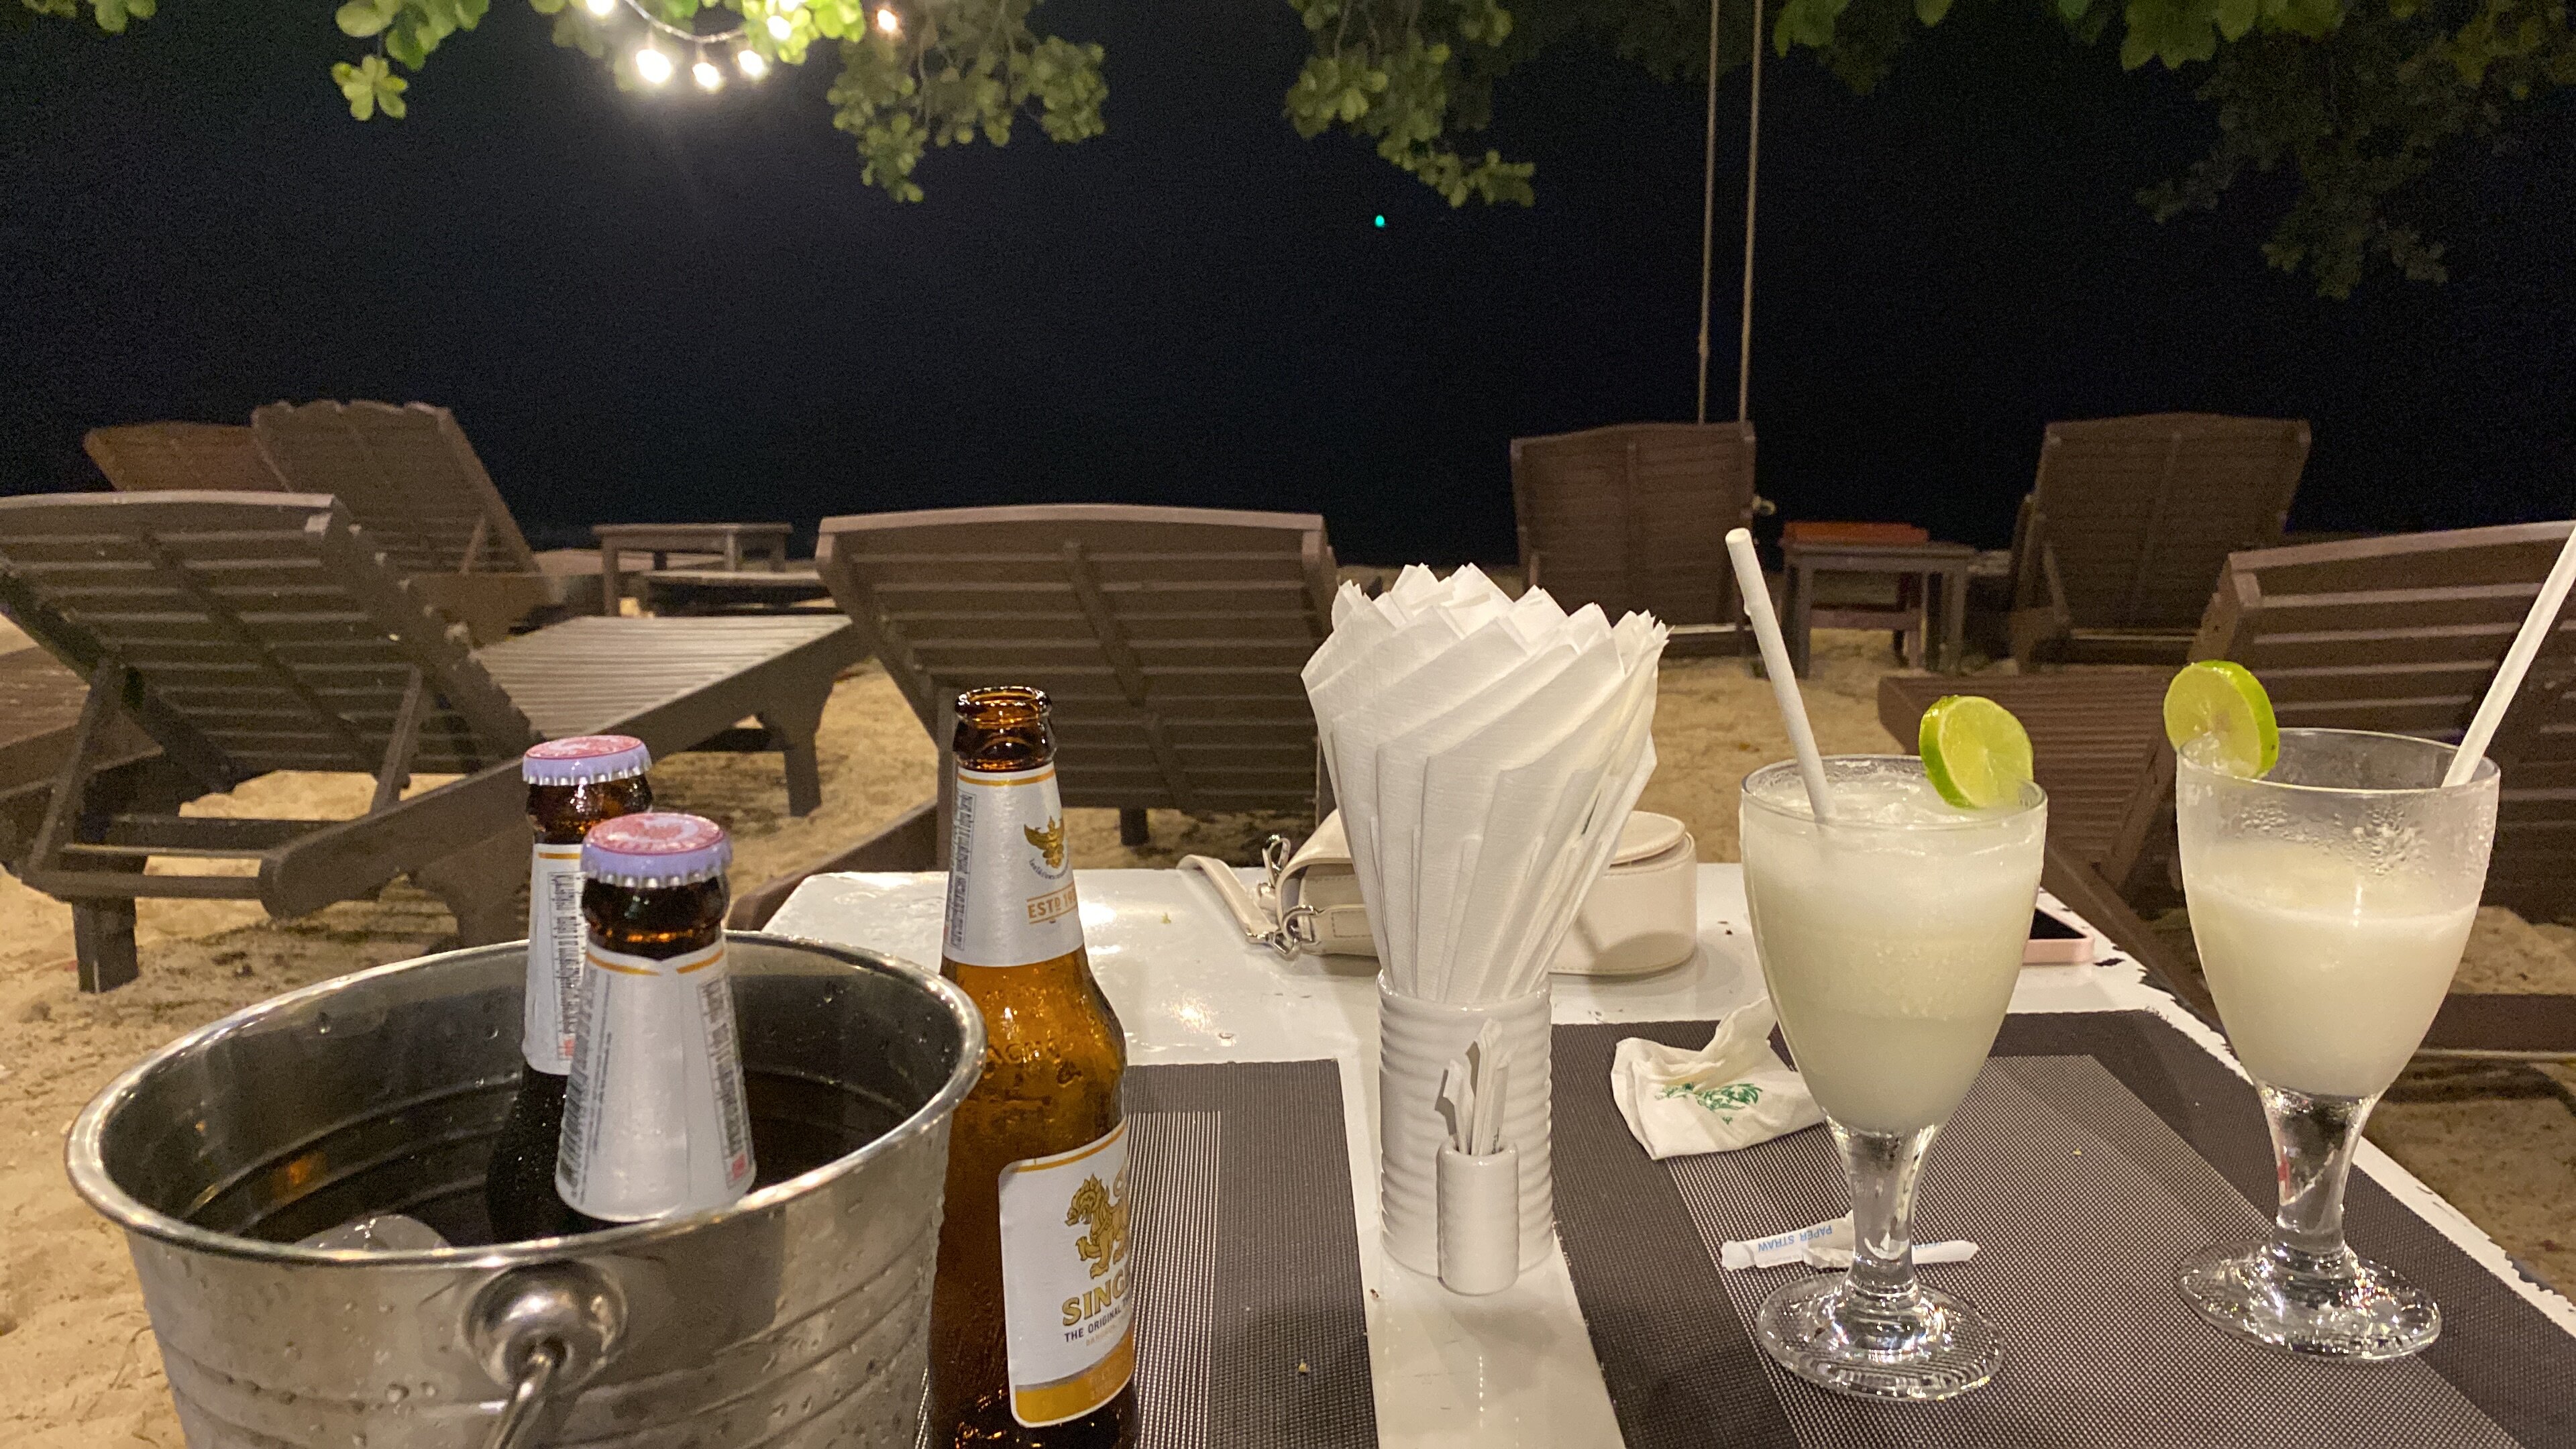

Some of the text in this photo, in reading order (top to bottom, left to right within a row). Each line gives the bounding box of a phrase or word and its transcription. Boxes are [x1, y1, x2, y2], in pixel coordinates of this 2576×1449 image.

[1758, 1224, 1833, 1252] PAPER STRAW
[1064, 1328, 1084, 1343] THE
[1087, 1305, 1122, 1334] ORIGINAL
